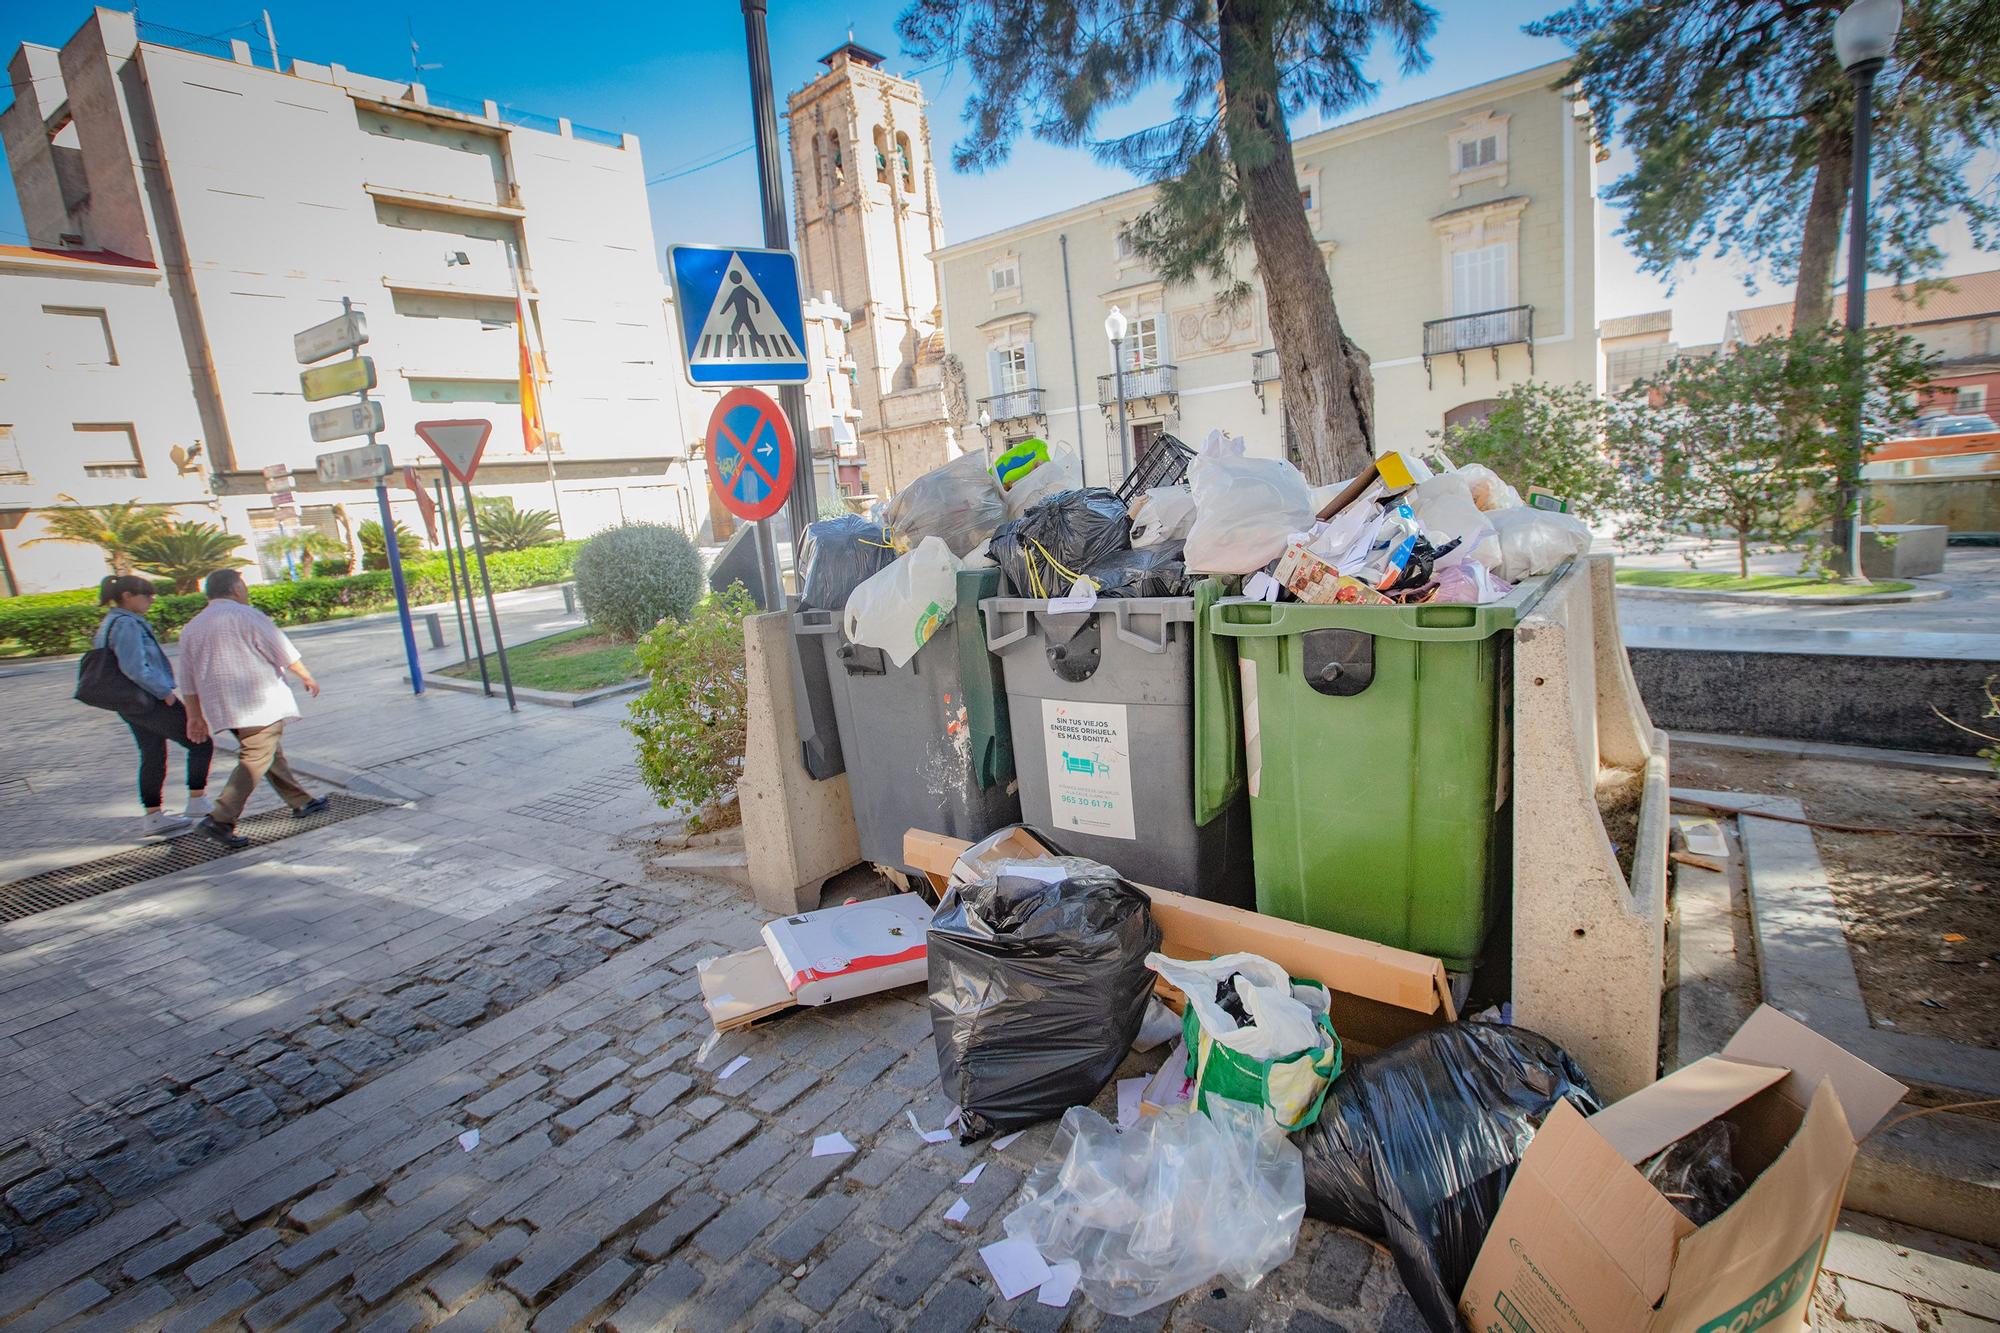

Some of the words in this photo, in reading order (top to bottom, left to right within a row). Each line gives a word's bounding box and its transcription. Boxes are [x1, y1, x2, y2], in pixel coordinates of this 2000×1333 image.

[1056, 717, 1067, 725] SIN
[1069, 718, 1082, 726] TUS
[1083, 719, 1109, 728] VIEJOS
[1050, 724, 1080, 733] ENSERES
[1080, 727, 1117, 736] ORIHUELA
[1067, 732, 1082, 741] MÁS
[1082, 735, 1112, 744] BONITA.
[1061, 794, 1076, 804] 965
[1078, 797, 1089, 806] 30
[1091, 799, 1100, 807] 61
[1103, 800, 1113, 809] 78
